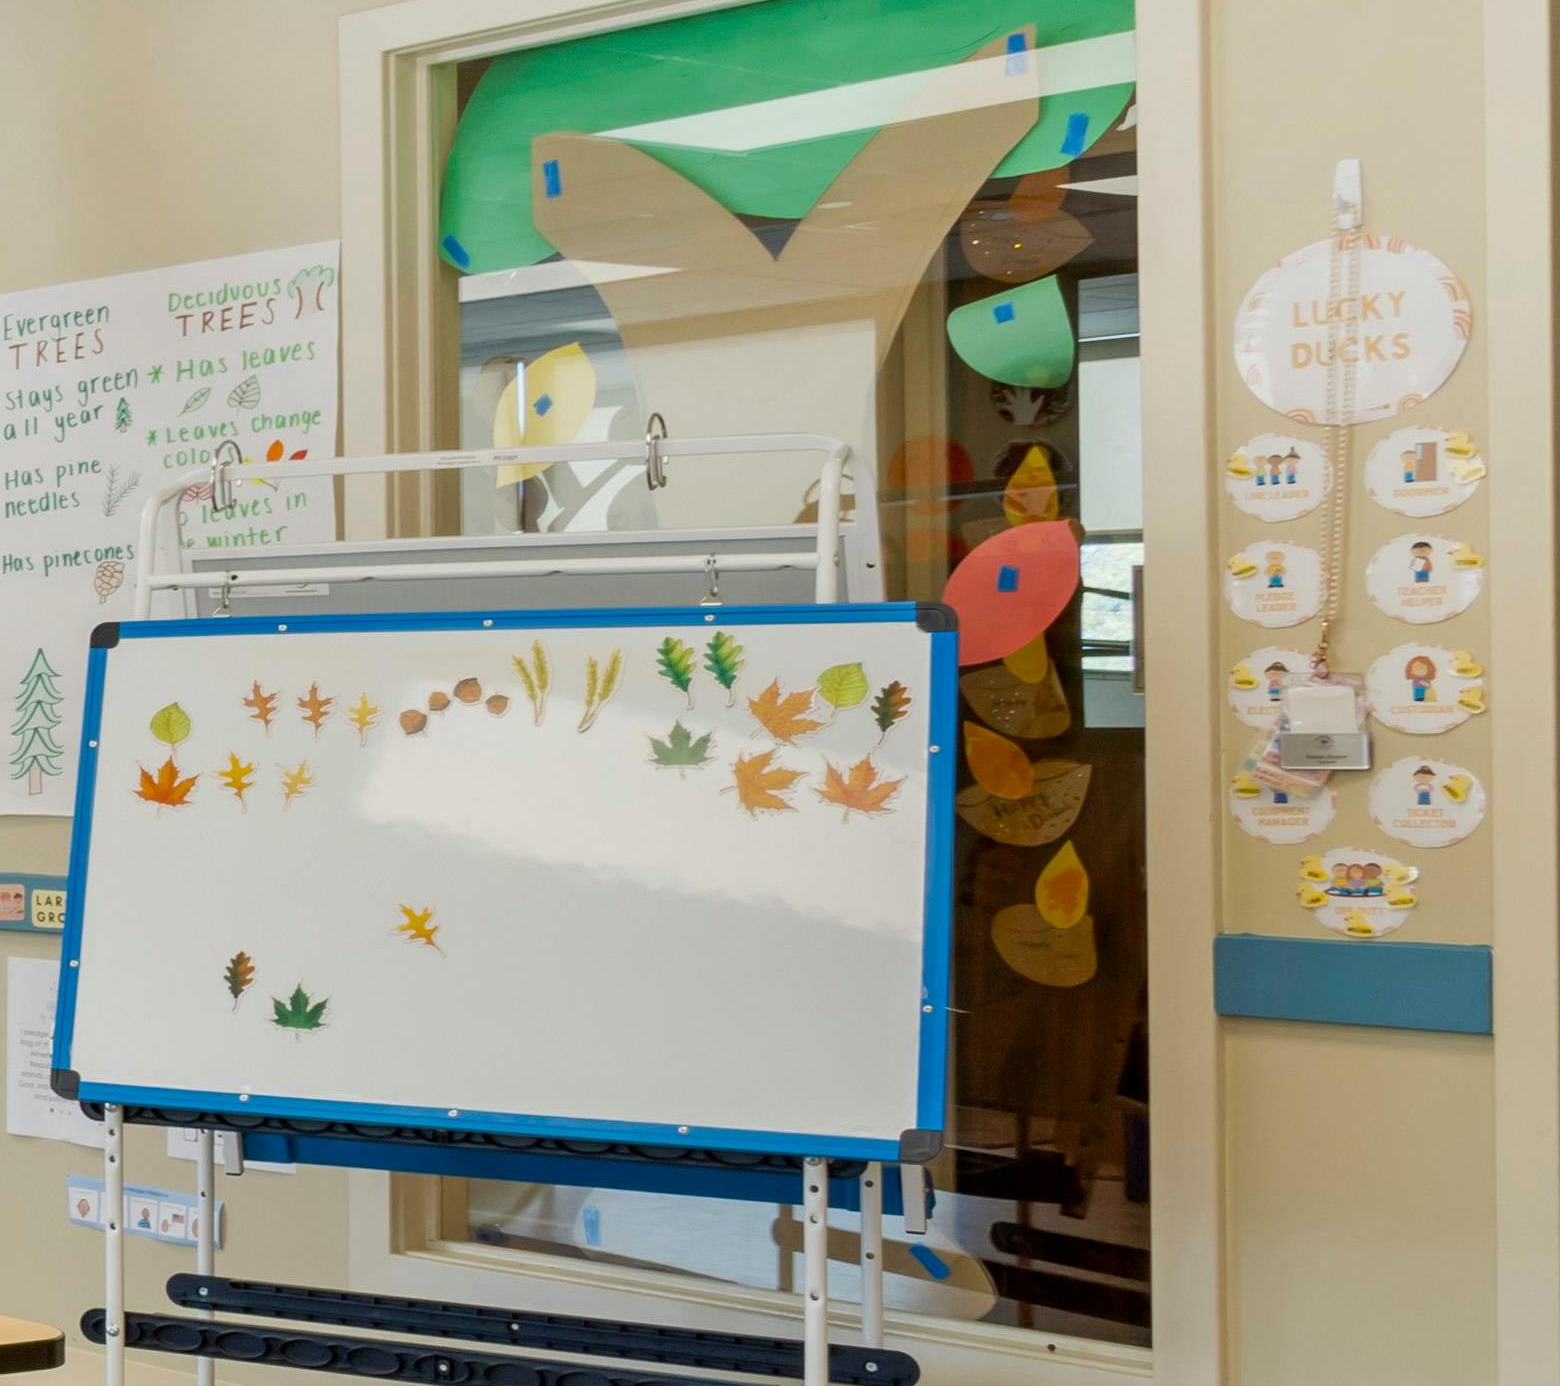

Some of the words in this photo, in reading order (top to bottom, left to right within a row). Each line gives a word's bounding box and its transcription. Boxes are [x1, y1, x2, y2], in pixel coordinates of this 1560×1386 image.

[2, 305, 110, 341] Evergreen
[175, 298, 276, 337] TREES
[1292, 291, 1406, 328] LUCKY
[8, 328, 105, 370] TREES
[175, 360, 228, 383] Has
[242, 340, 315, 371] leaves
[1290, 333, 1411, 369] DUCKS
[77, 367, 139, 407] green
[3, 416, 39, 441] all
[54, 403, 104, 443] year
[165, 421, 240, 445] Leaves
[251, 409, 323, 434] change
[3, 467, 45, 490] Has
[56, 460, 103, 488] pine
[4, 491, 80, 519] needles
[201, 497, 272, 528] leaves
[286, 491, 308, 511] in
[207, 525, 288, 548] winter
[2, 553, 34, 575] Has
[43, 544, 135, 577] pinecones
